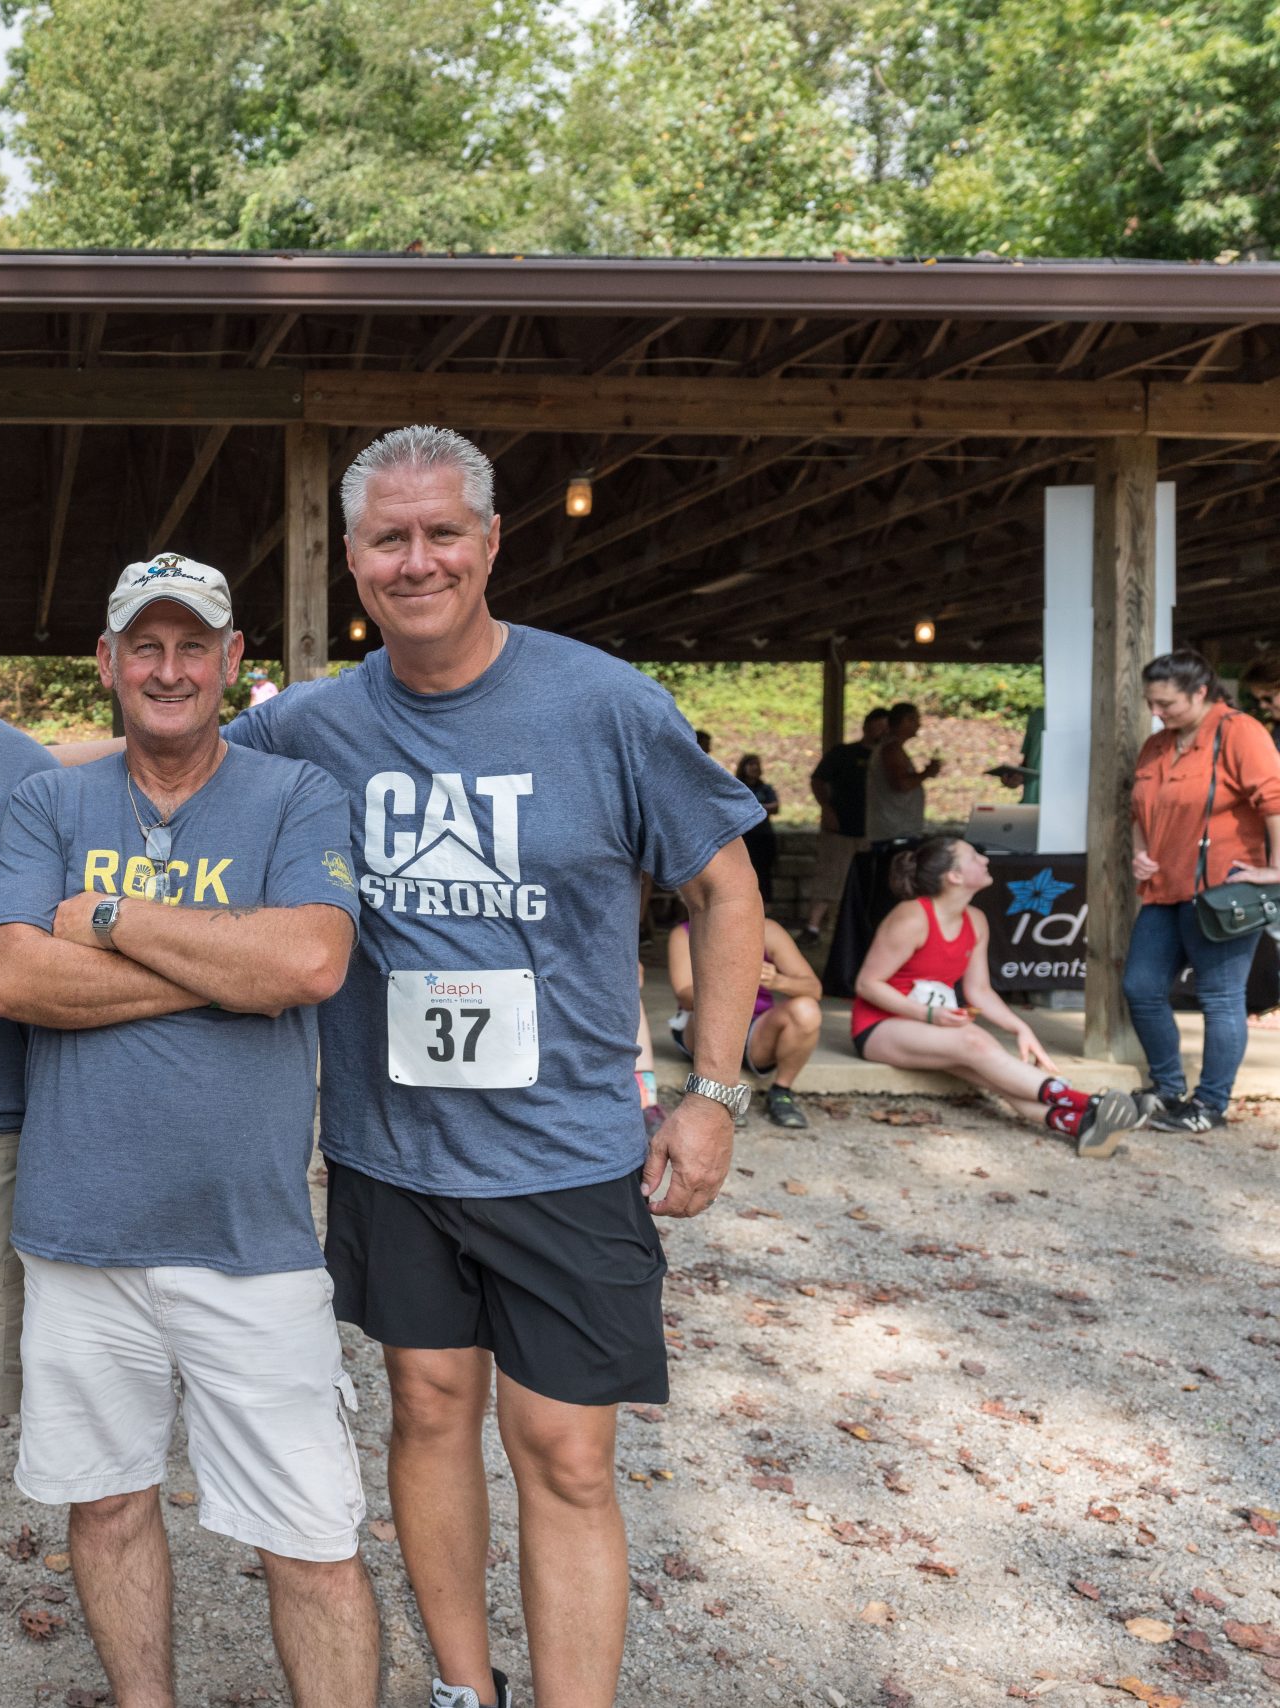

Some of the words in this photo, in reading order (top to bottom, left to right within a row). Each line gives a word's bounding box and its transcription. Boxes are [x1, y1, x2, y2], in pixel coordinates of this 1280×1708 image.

[171, 567, 207, 583] Beach
[364, 771, 534, 883] CAT
[84, 849, 234, 906] ROCK
[360, 874, 547, 921] STRONG
[1010, 903, 1088, 947] id
[430, 981, 482, 997] idaph
[425, 1007, 491, 1063] 37
